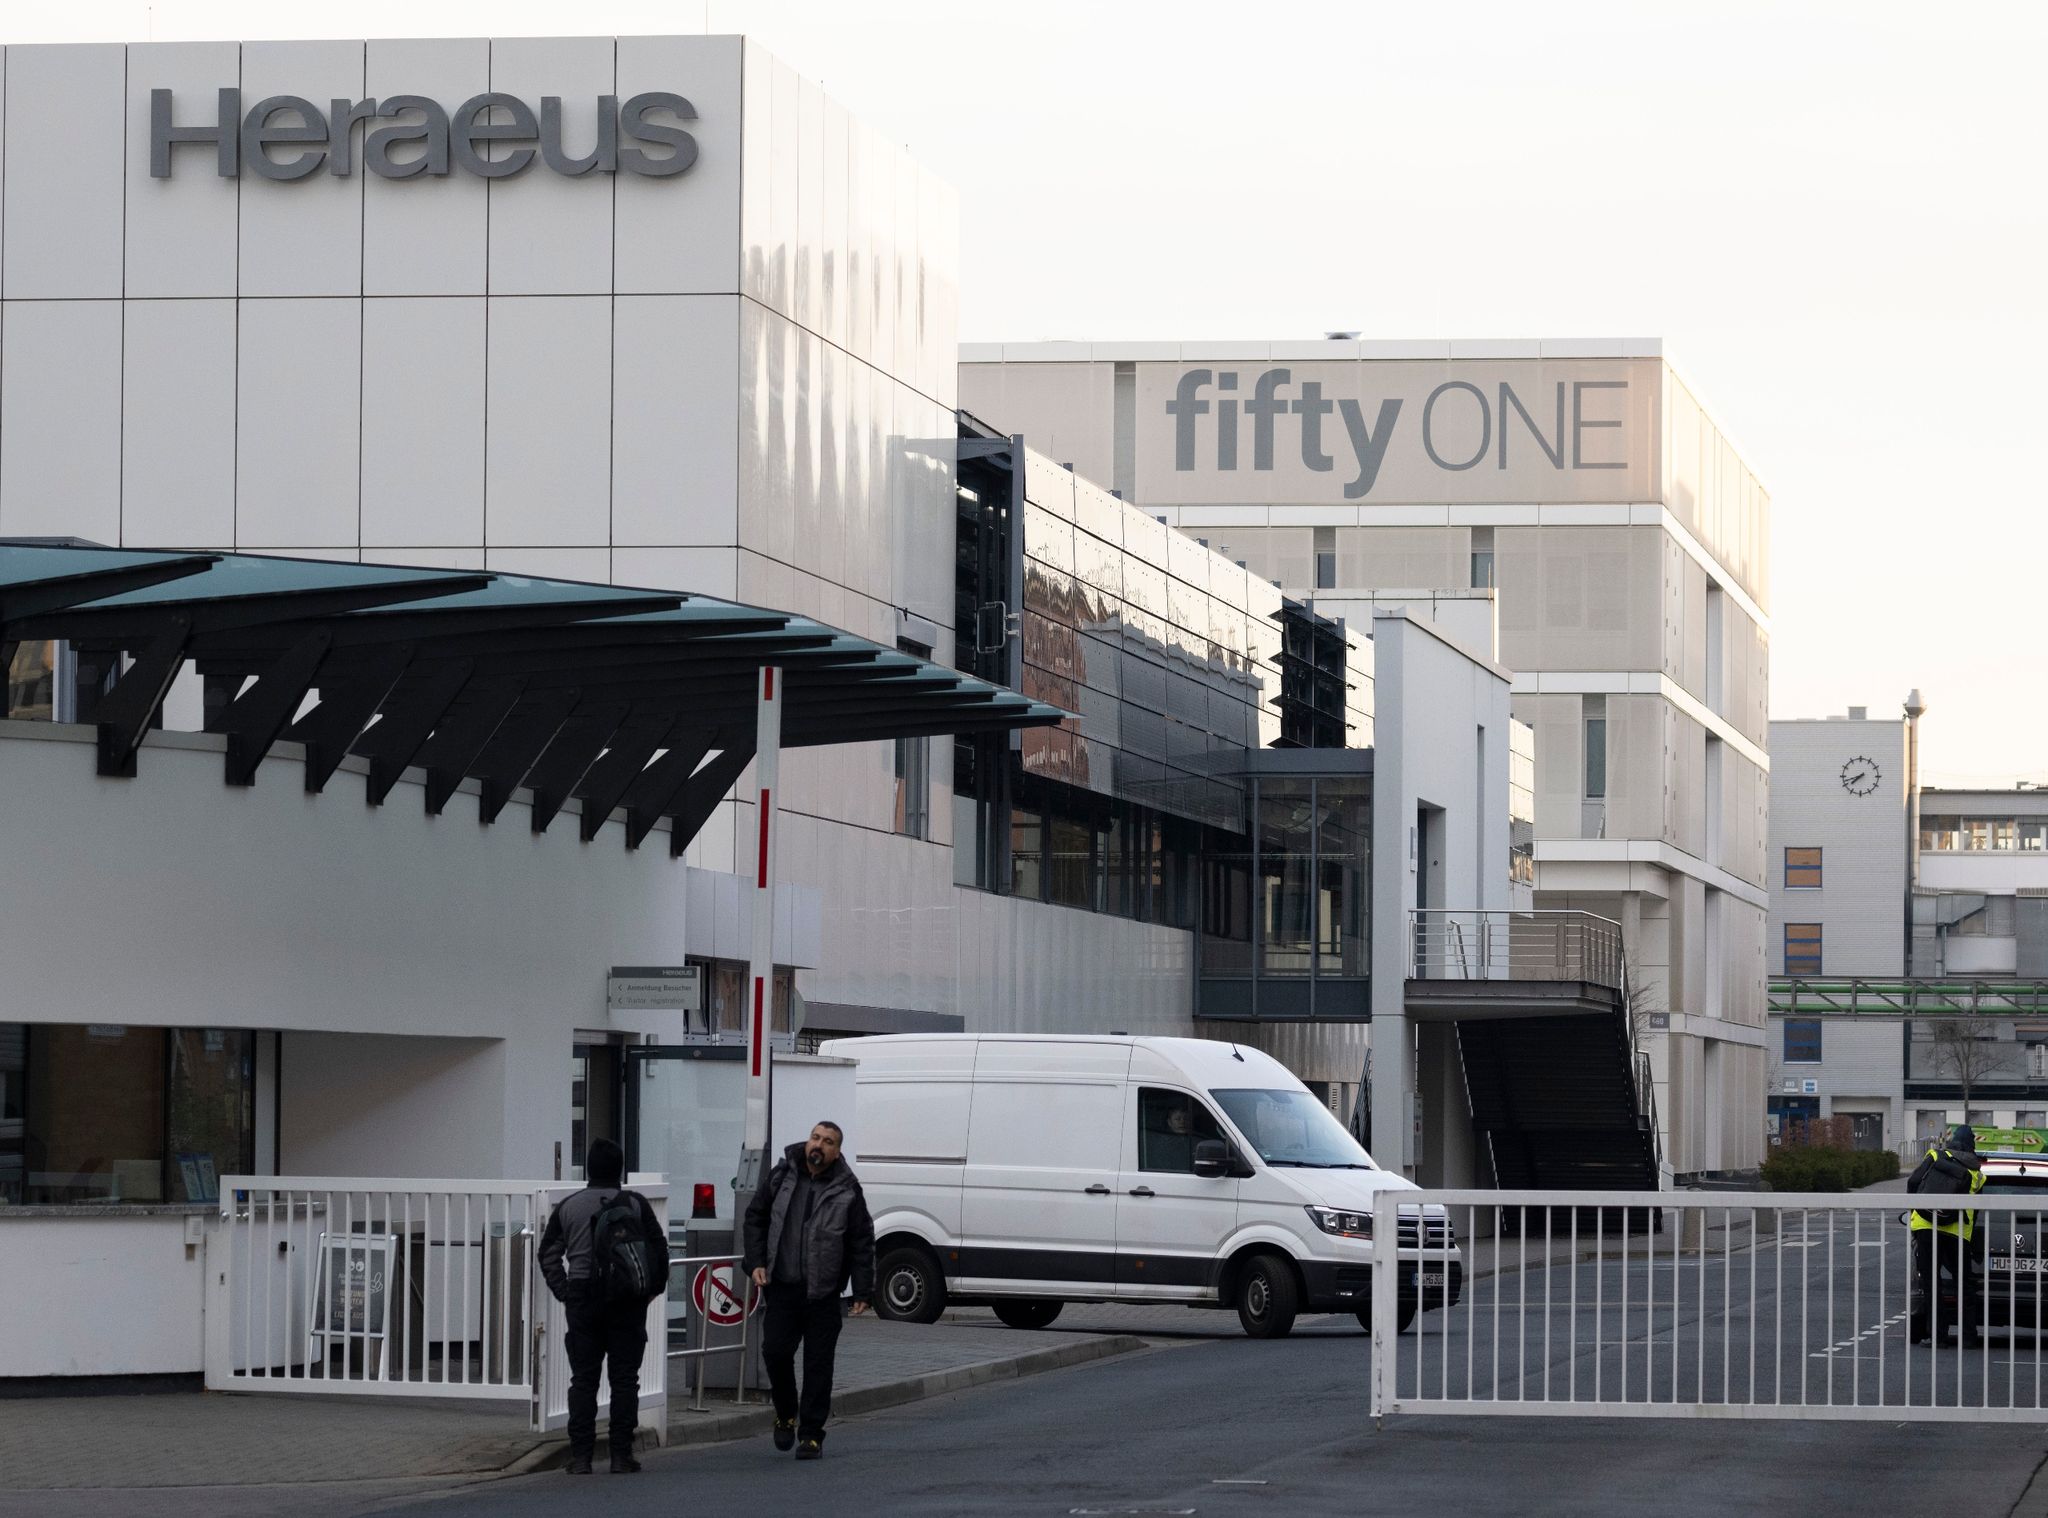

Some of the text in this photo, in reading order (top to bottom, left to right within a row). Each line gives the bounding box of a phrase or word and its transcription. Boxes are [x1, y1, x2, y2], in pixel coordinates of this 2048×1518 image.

[150, 88, 699, 180] Heraeus
[1165, 368, 1629, 499] fifty ONE
[1992, 1259, 2006, 1269] HU
